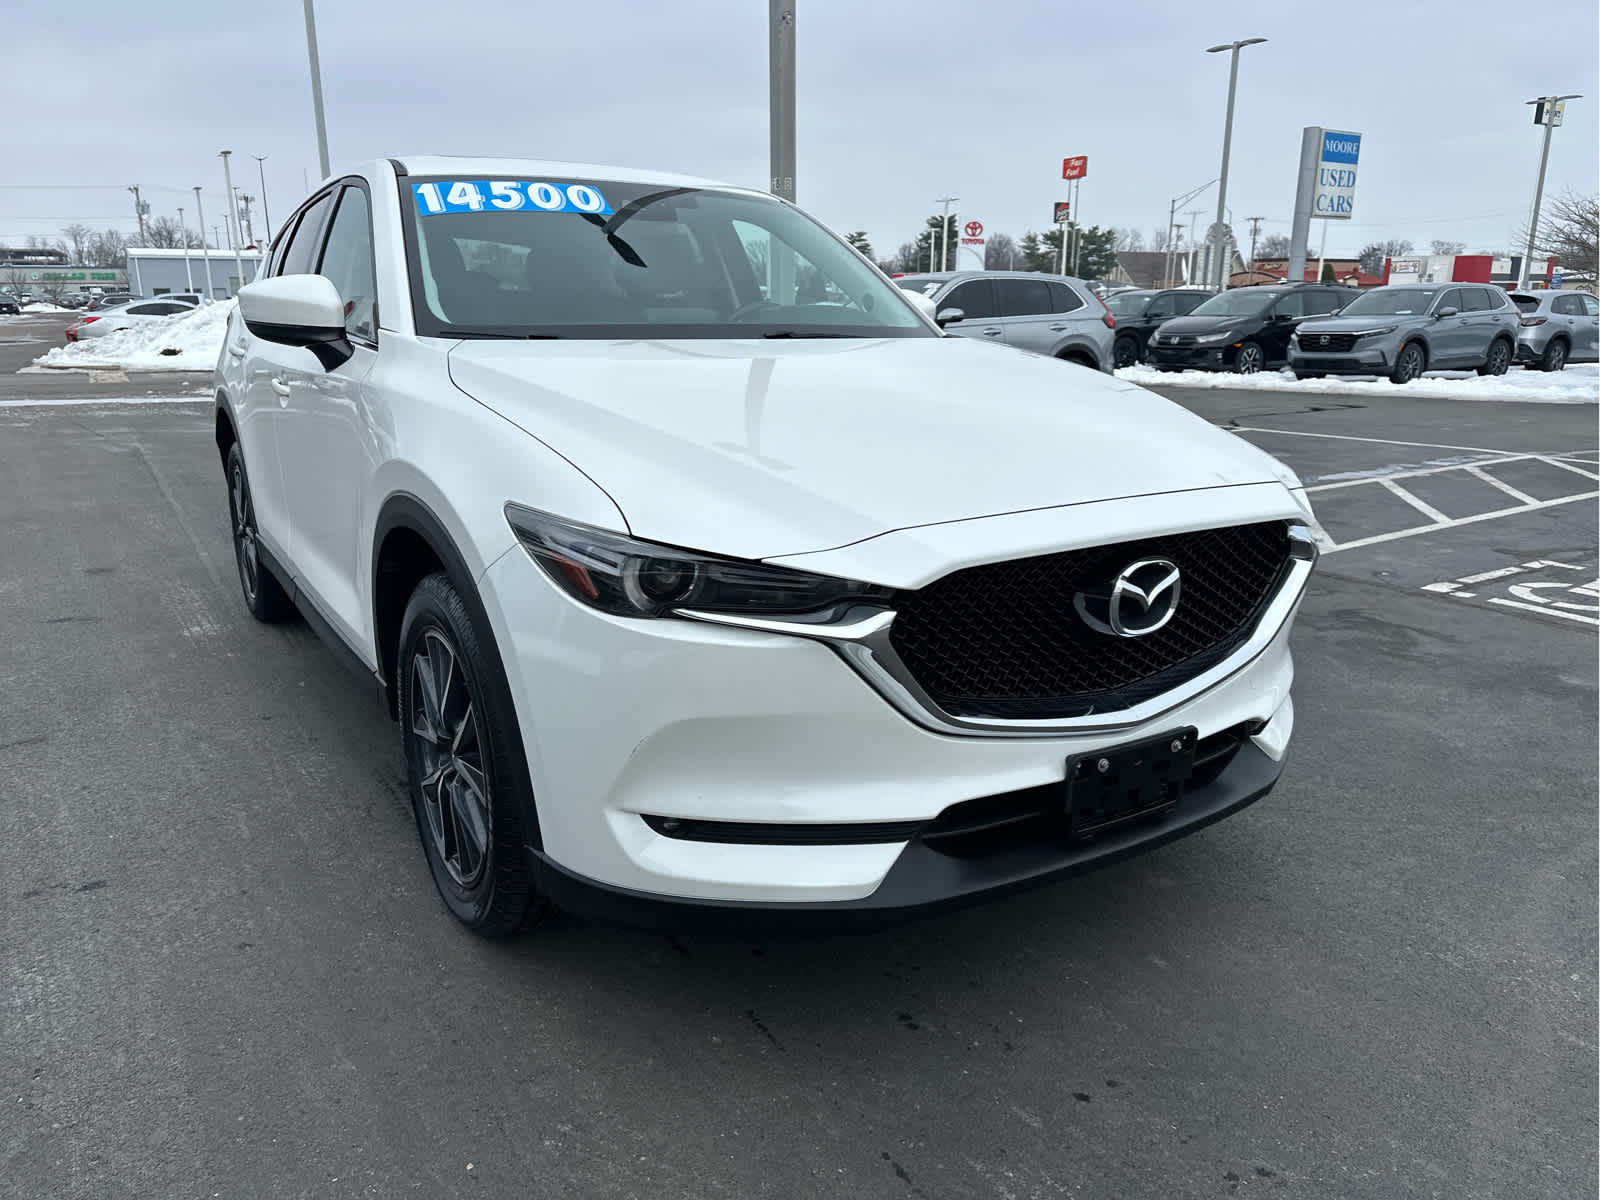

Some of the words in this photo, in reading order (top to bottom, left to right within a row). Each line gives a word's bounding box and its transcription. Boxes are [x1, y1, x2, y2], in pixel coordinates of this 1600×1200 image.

[1326, 139, 1359, 154] MOORE
[1320, 168, 1356, 188] USED
[416, 181, 606, 213] 14500
[1316, 193, 1353, 213] CARS
